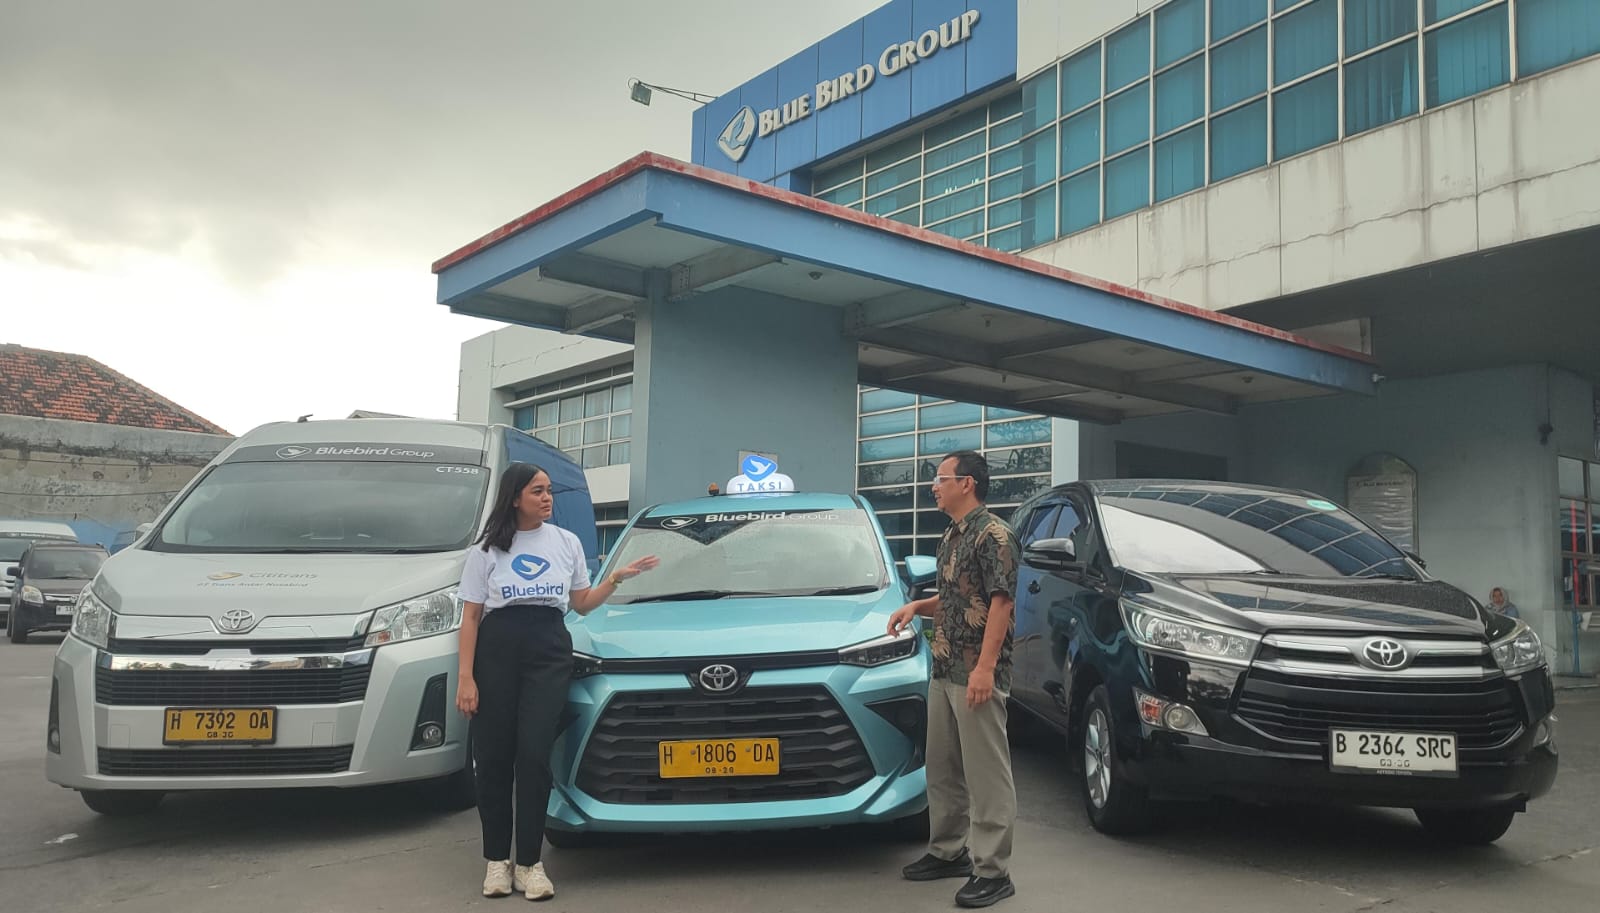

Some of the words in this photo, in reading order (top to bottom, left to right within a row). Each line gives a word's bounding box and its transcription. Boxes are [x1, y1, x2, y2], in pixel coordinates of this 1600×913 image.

[759, 93, 811, 138] BLUE
[815, 63, 876, 112] BIRD
[878, 9, 980, 76] GROUP
[315, 447, 389, 456] Bluebird
[390, 449, 435, 458] Group
[436, 466, 479, 475] CT558
[737, 481, 783, 492] TAKSI
[705, 512, 786, 523] Bluebird
[249, 571, 318, 579] Cititrans
[501, 582, 564, 599] Bluebird
[171, 713, 181, 730] H
[195, 711, 236, 729] 7392
[1336, 733, 1347, 753] B
[1358, 734, 1405, 757] 2364
[1416, 736, 1452, 759] SRC
[663, 745, 673, 765] H
[695, 743, 737, 763] 1806
